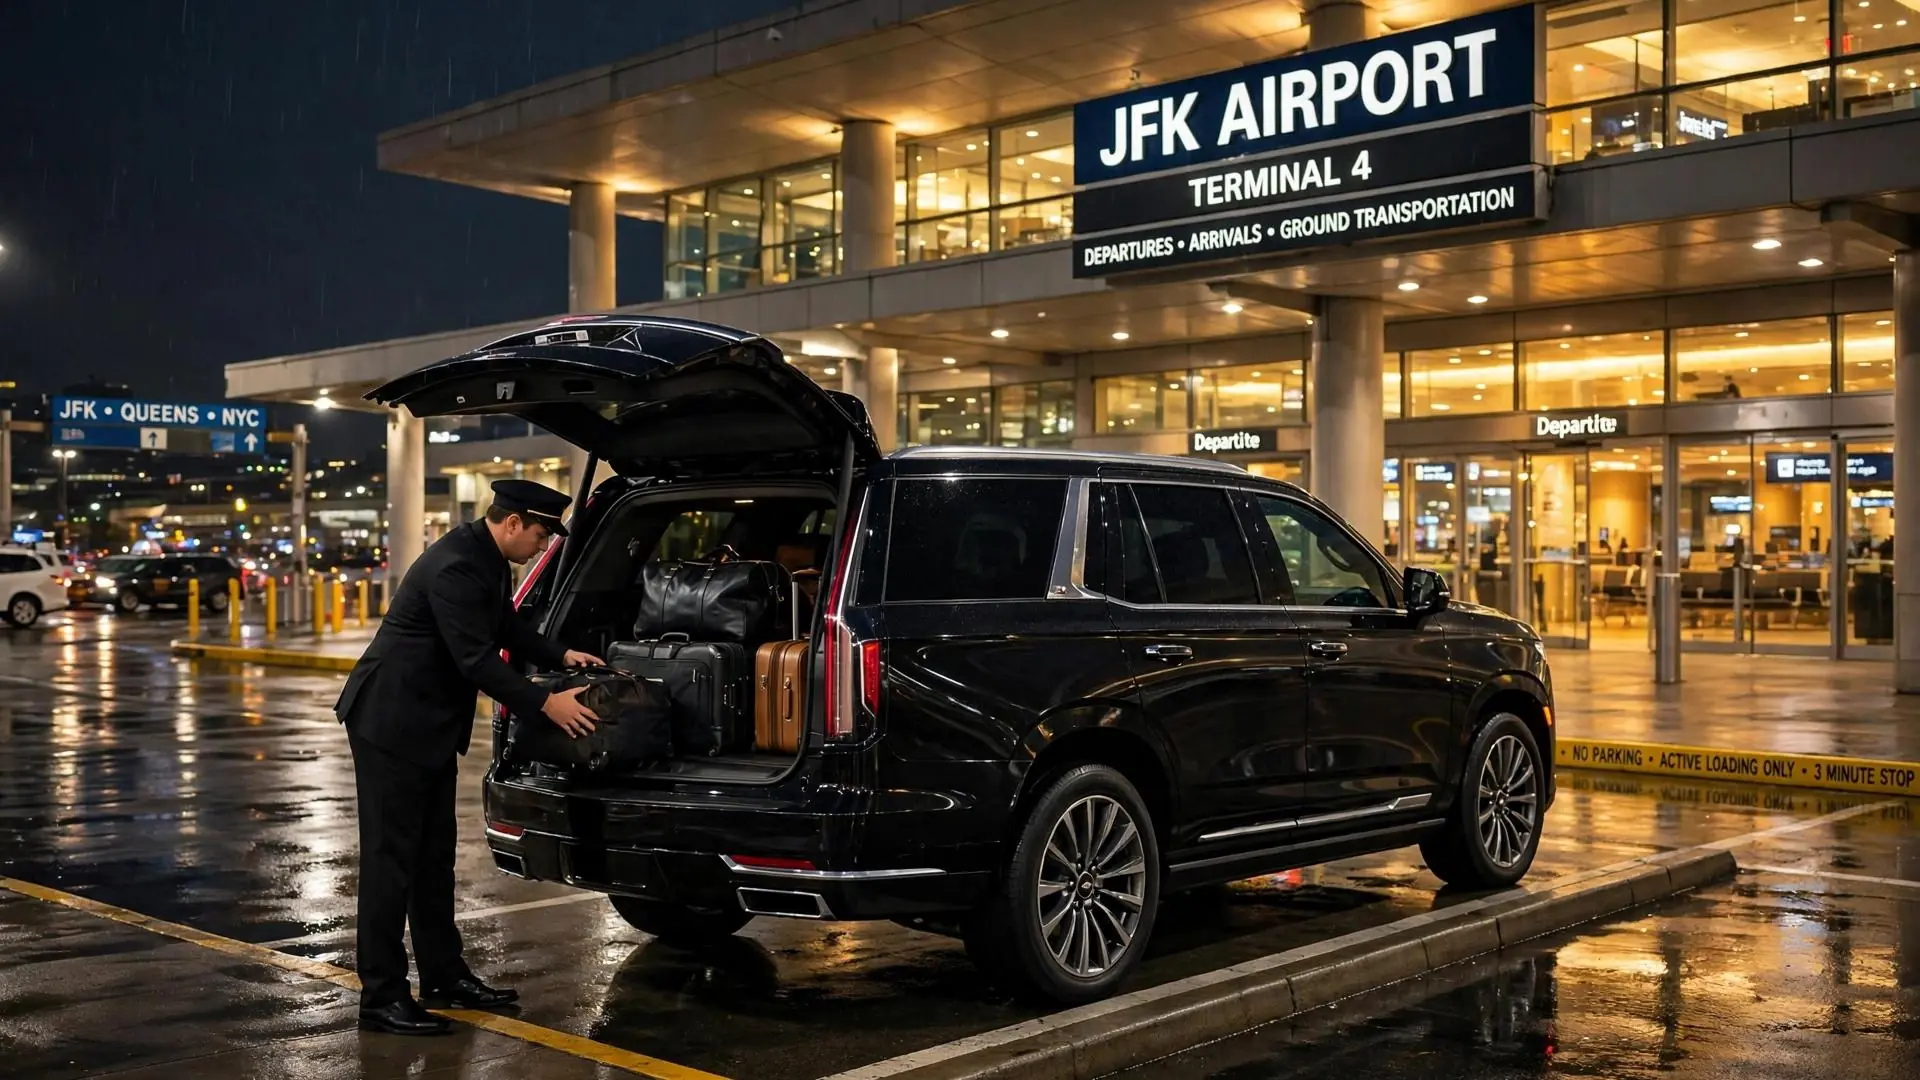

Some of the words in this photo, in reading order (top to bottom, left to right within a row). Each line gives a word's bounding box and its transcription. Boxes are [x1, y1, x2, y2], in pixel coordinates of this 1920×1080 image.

[1100, 91, 1201, 168] JFK
[1217, 28, 1497, 147] AIRPORT
[1188, 156, 1342, 208] TERMINAL
[1351, 149, 1373, 181] 4
[1084, 236, 1174, 267] DEPARTURES
[1188, 223, 1262, 252] ARRIVALS
[1280, 211, 1350, 240] GROUND
[1353, 186, 1515, 229] TRANSPORTATION
[59, 400, 97, 419] JFK
[120, 402, 200, 425] QUEENS
[222, 407, 260, 427] NYC
[1572, 745, 1589, 762] NO
[1592, 746, 1643, 766] PARKING
[1660, 752, 1702, 770] ACTIVE
[1706, 755, 1759, 775] LOADING
[1763, 759, 1795, 778] ONLY
[1814, 763, 1822, 781] 3
[1826, 764, 1876, 785] MINUTE
[1880, 768, 1916, 788] STOP
